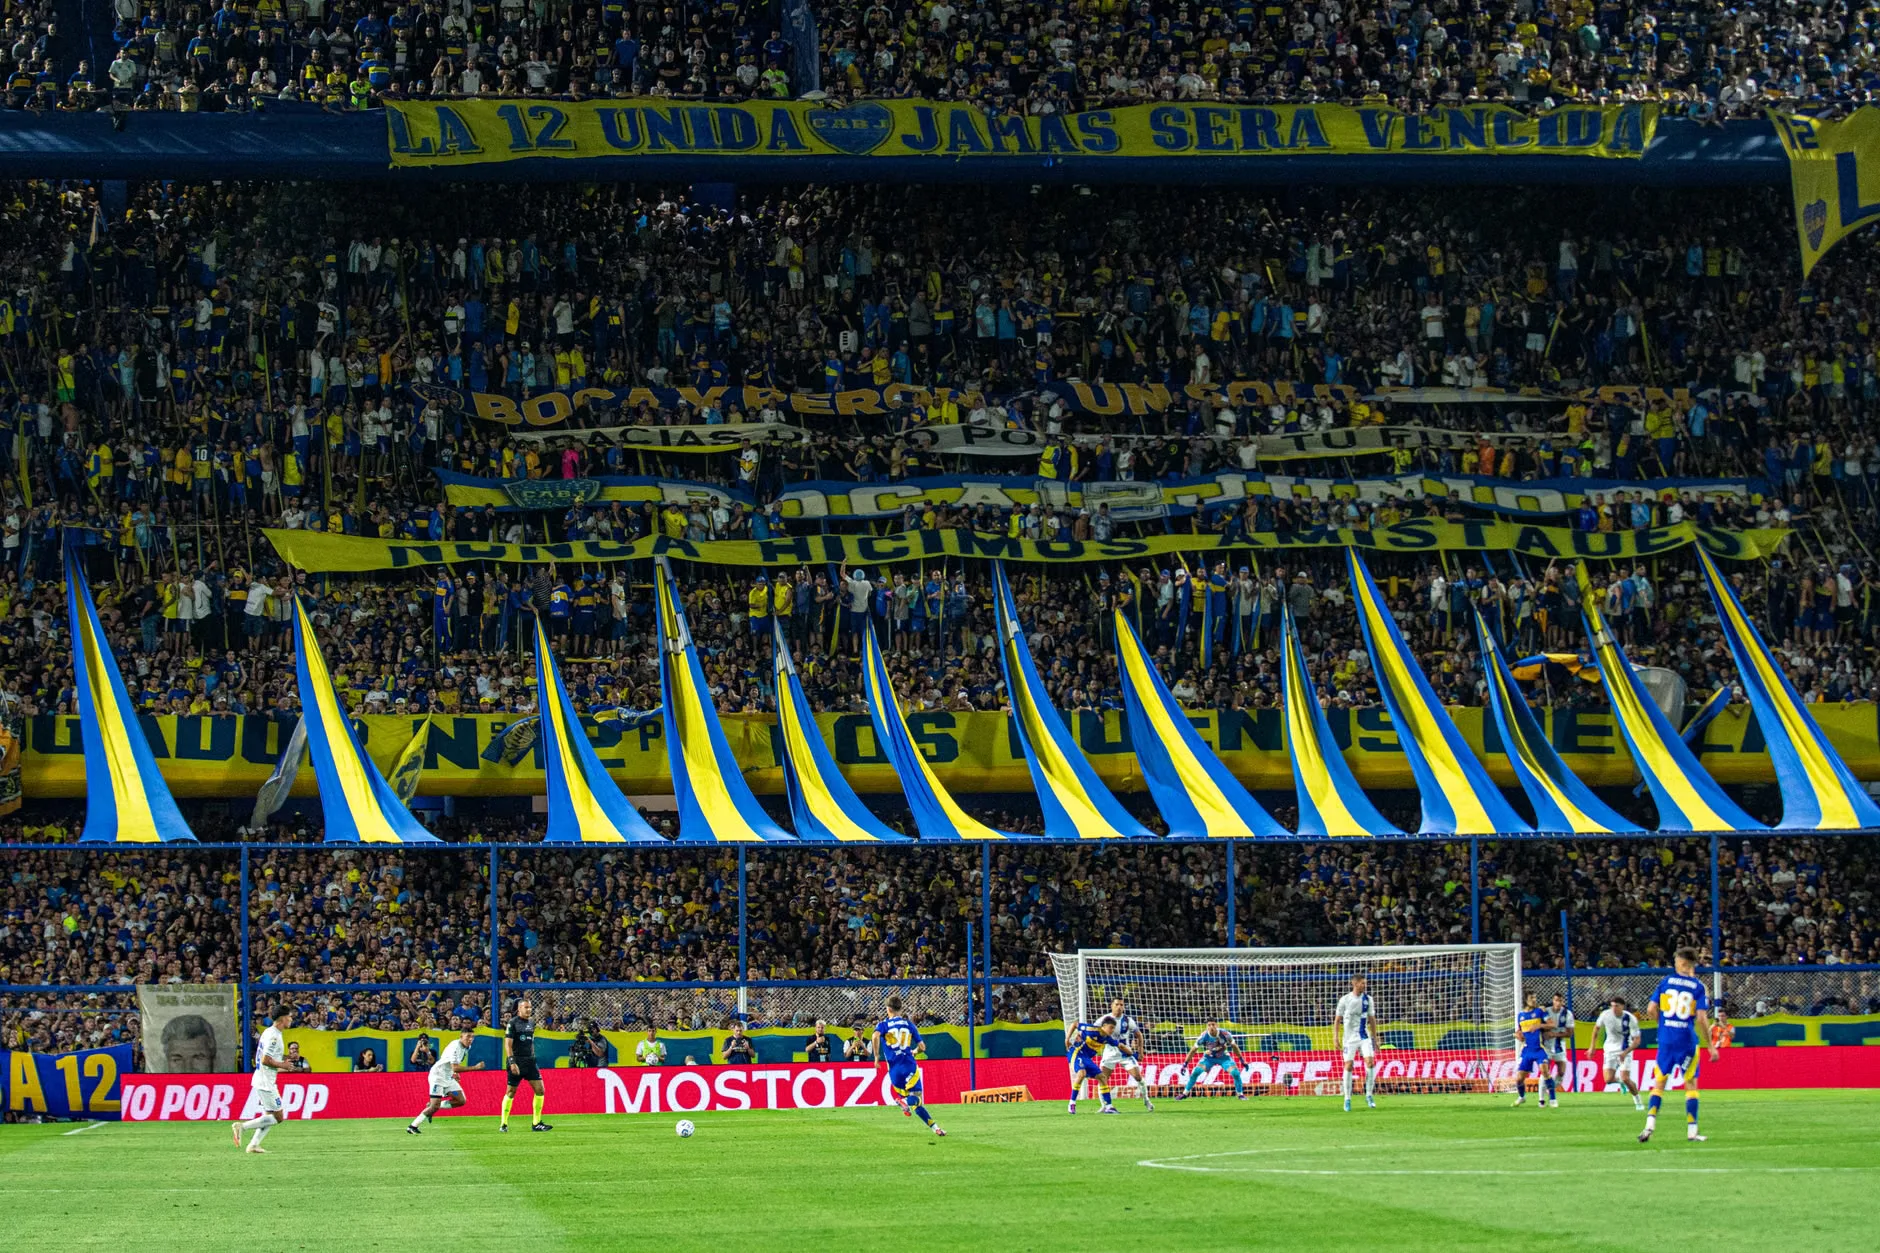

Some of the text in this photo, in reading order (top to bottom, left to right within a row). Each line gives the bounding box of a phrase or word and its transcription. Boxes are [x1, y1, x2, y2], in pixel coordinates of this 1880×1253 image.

[393, 104, 1648, 156] LA 12 UNIDA JAMAS SERA VENCIDA
[813, 118, 890, 129] CABJ
[1071, 382, 1172, 415] UN
[195, 449, 208, 461] 10
[534, 428, 743, 449] RACIAS
[388, 536, 700, 567] NUNCA
[758, 529, 1148, 562] HICIMOS
[769, 711, 959, 765] OS
[1663, 988, 1694, 1020] 38
[55, 1054, 121, 1112] 12
[160, 1085, 235, 1120] POR
